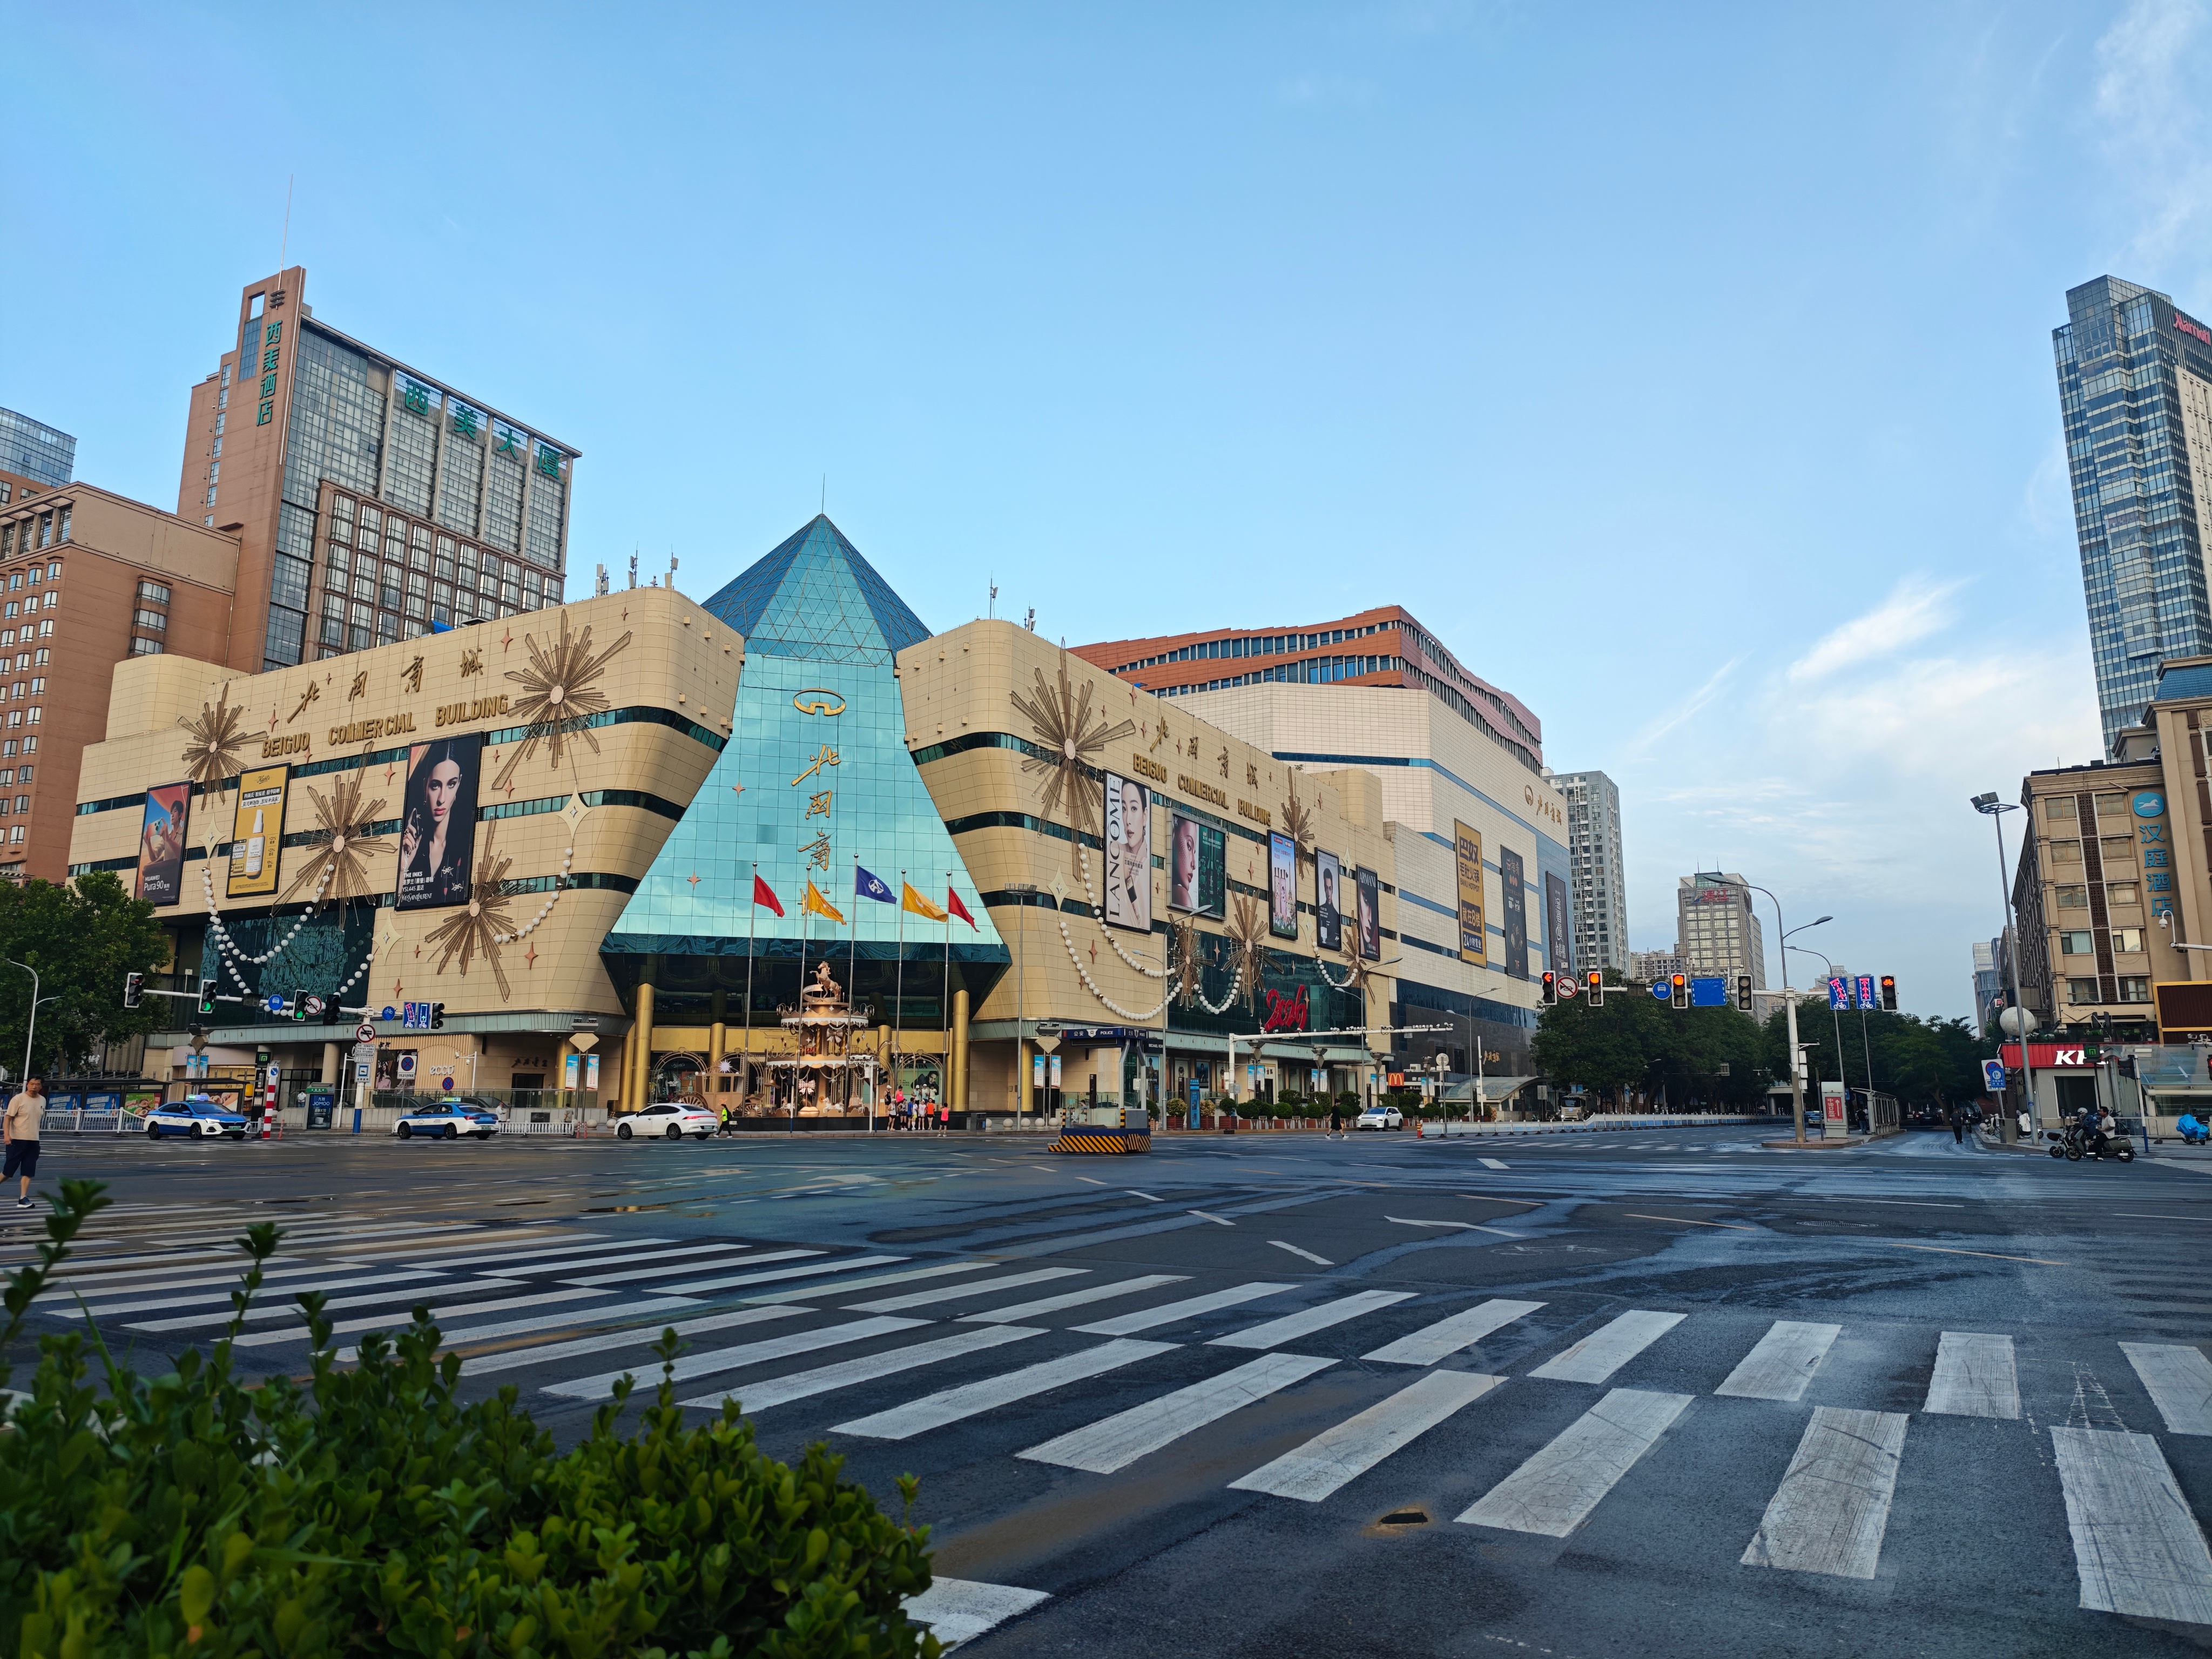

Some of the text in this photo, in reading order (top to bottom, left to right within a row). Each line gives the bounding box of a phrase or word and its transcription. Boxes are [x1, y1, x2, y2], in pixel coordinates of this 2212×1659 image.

[256, 320, 282, 427] 西美酒店
[405, 378, 562, 480] 西美大厦
[287, 647, 483, 724] 北国商城
[261, 693, 509, 758] BEIGUO COMMERCIAL BUILDING
[1149, 716, 1259, 790] 北国商城
[1133, 753, 1272, 827] BEIGUO COMMERCIAL BUILDING
[1108, 777, 1121, 919] LANCÔME
[1459, 835, 1479, 866] 巴奴
[1359, 871, 1376, 888] ARMANI
[1459, 861, 1480, 885] 毛肚火锅
[1460, 878, 1480, 893] BANU HOTPOT
[2139, 824, 2174, 918] 汉庭酒店
[144, 882, 156, 892] Pura
[1462, 906, 1481, 928] 就在8楼
[1464, 934, 1482, 949] 24小时营业
[1514, 960, 1520, 970] 7F
[429, 1064, 455, 1075] ecco
